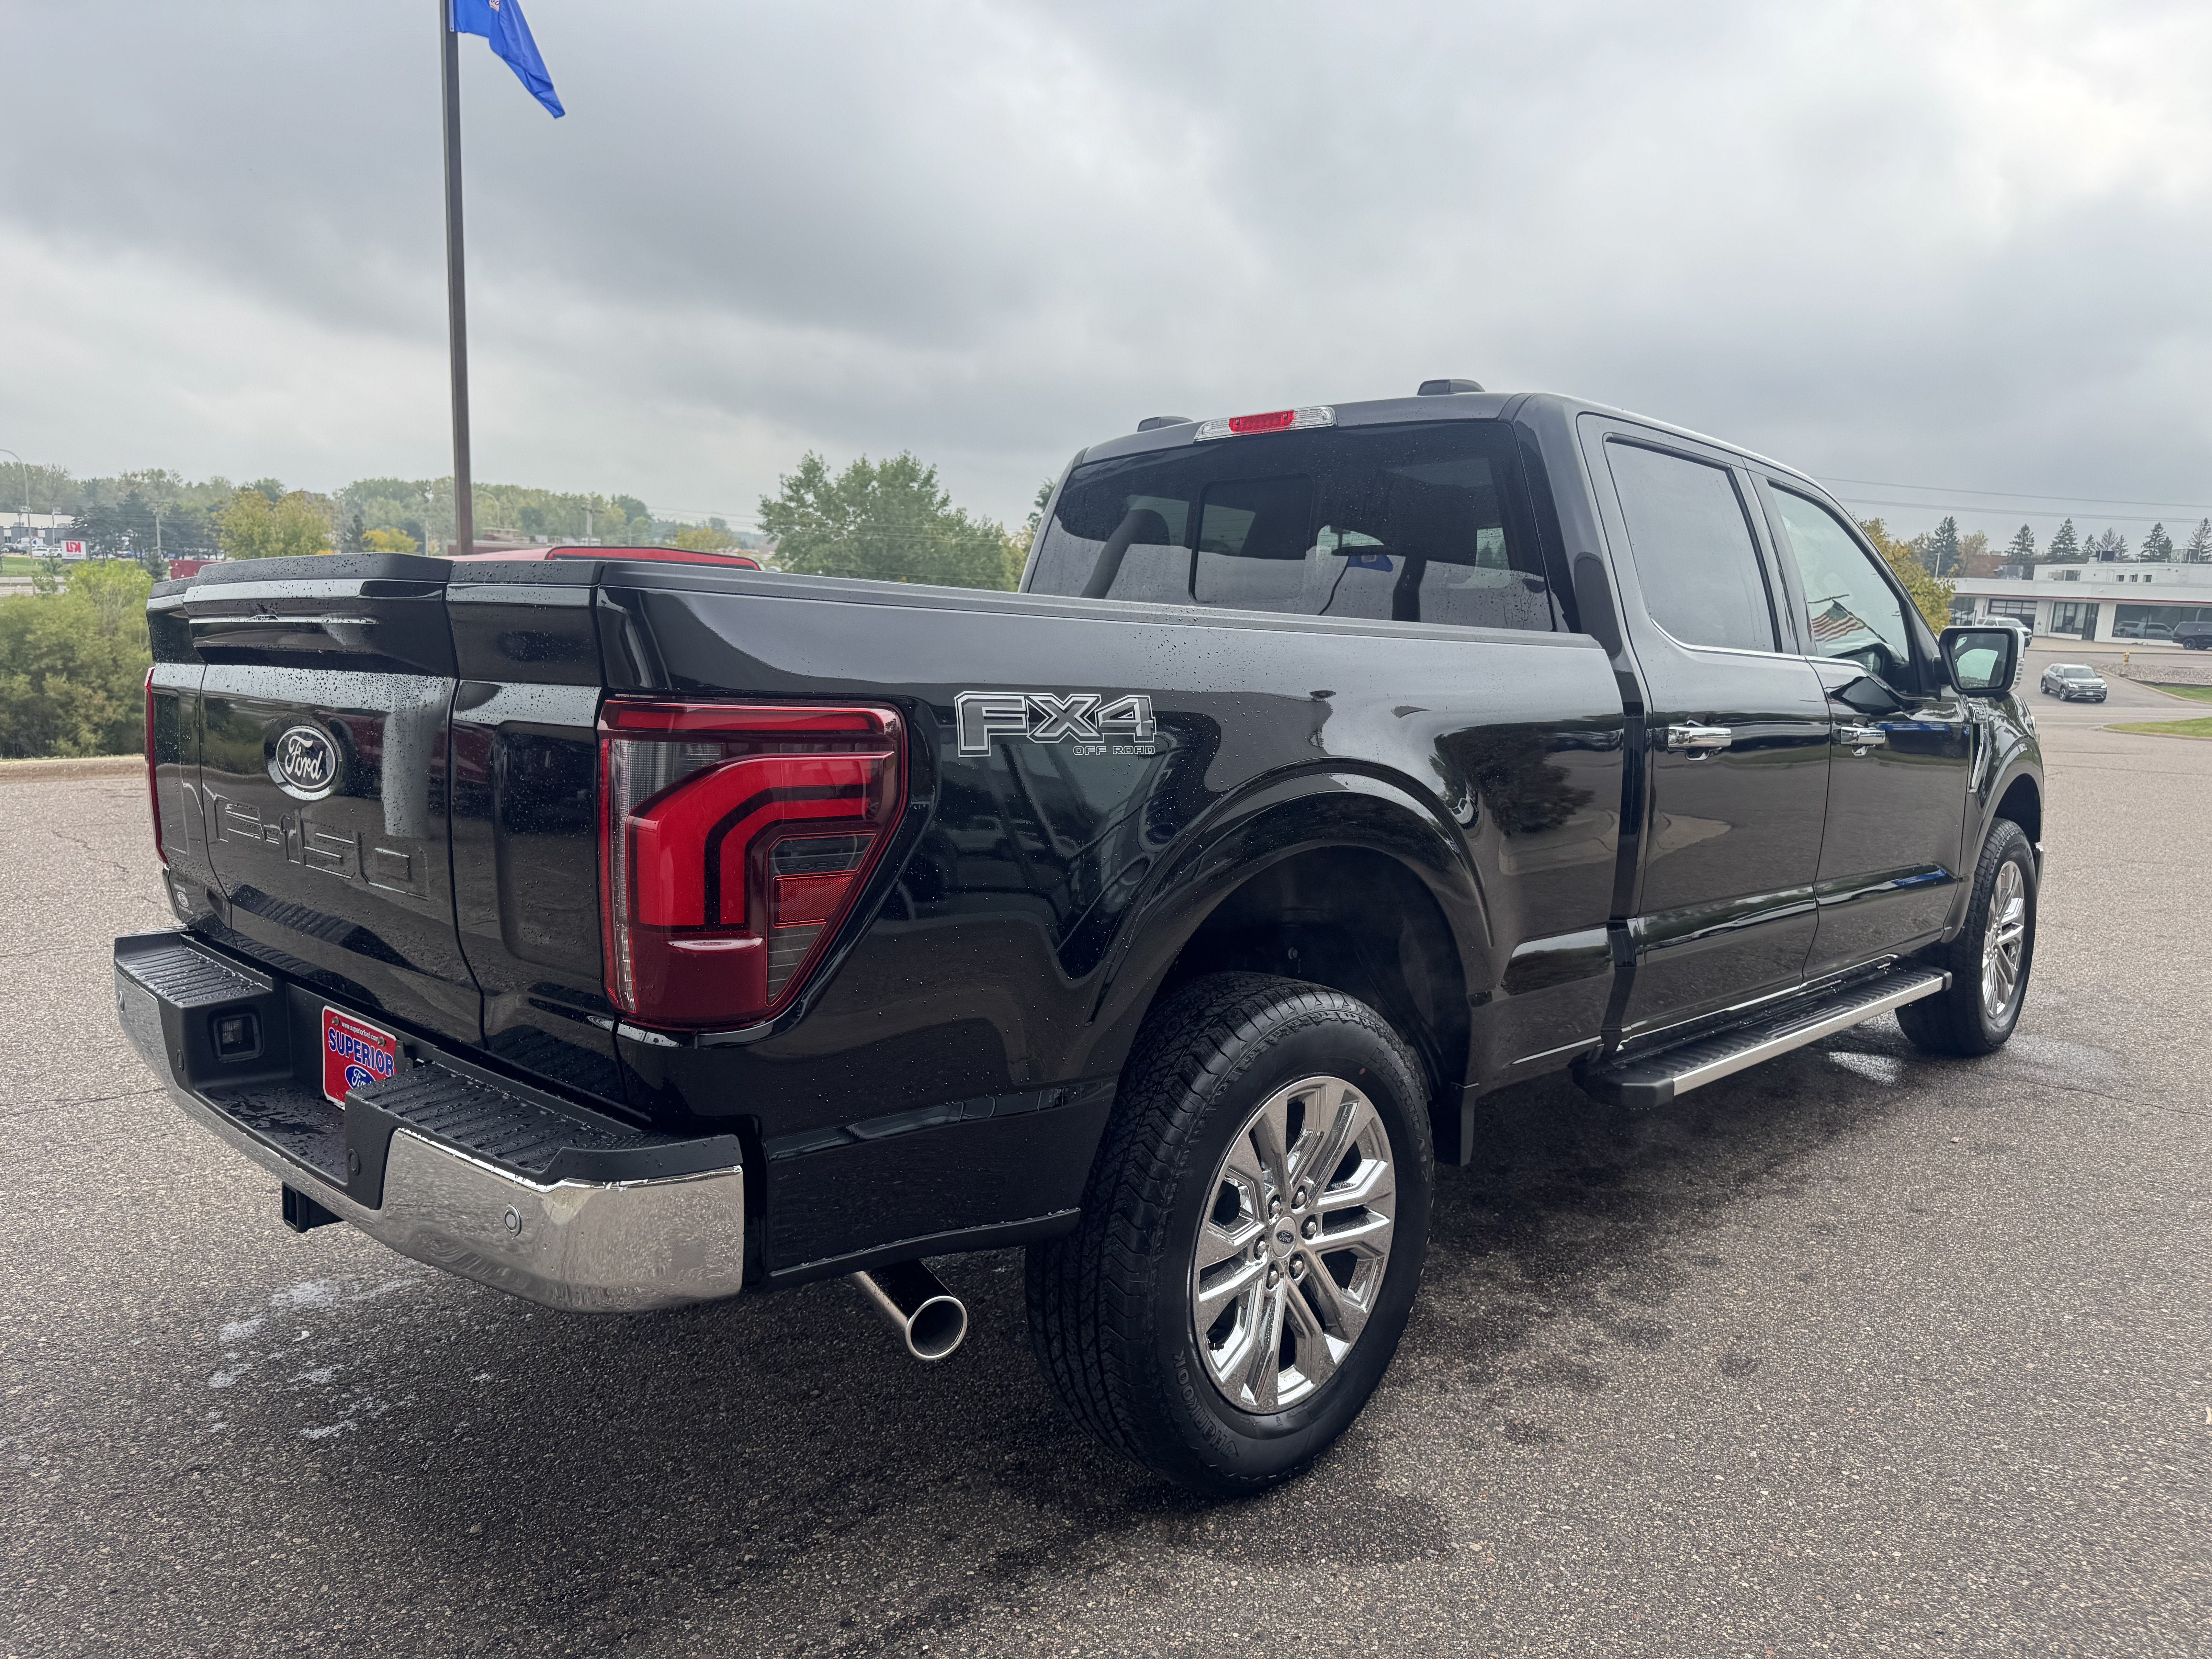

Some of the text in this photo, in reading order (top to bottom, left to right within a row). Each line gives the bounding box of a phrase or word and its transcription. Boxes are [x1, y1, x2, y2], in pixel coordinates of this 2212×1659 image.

[954, 691, 1157, 757] FX4
[285, 735, 323, 780] Ford
[1073, 745, 1155, 756] OFF ROAD
[328, 1027, 394, 1077] SUPERIOR
[1279, 1232, 1292, 1242] Ford
